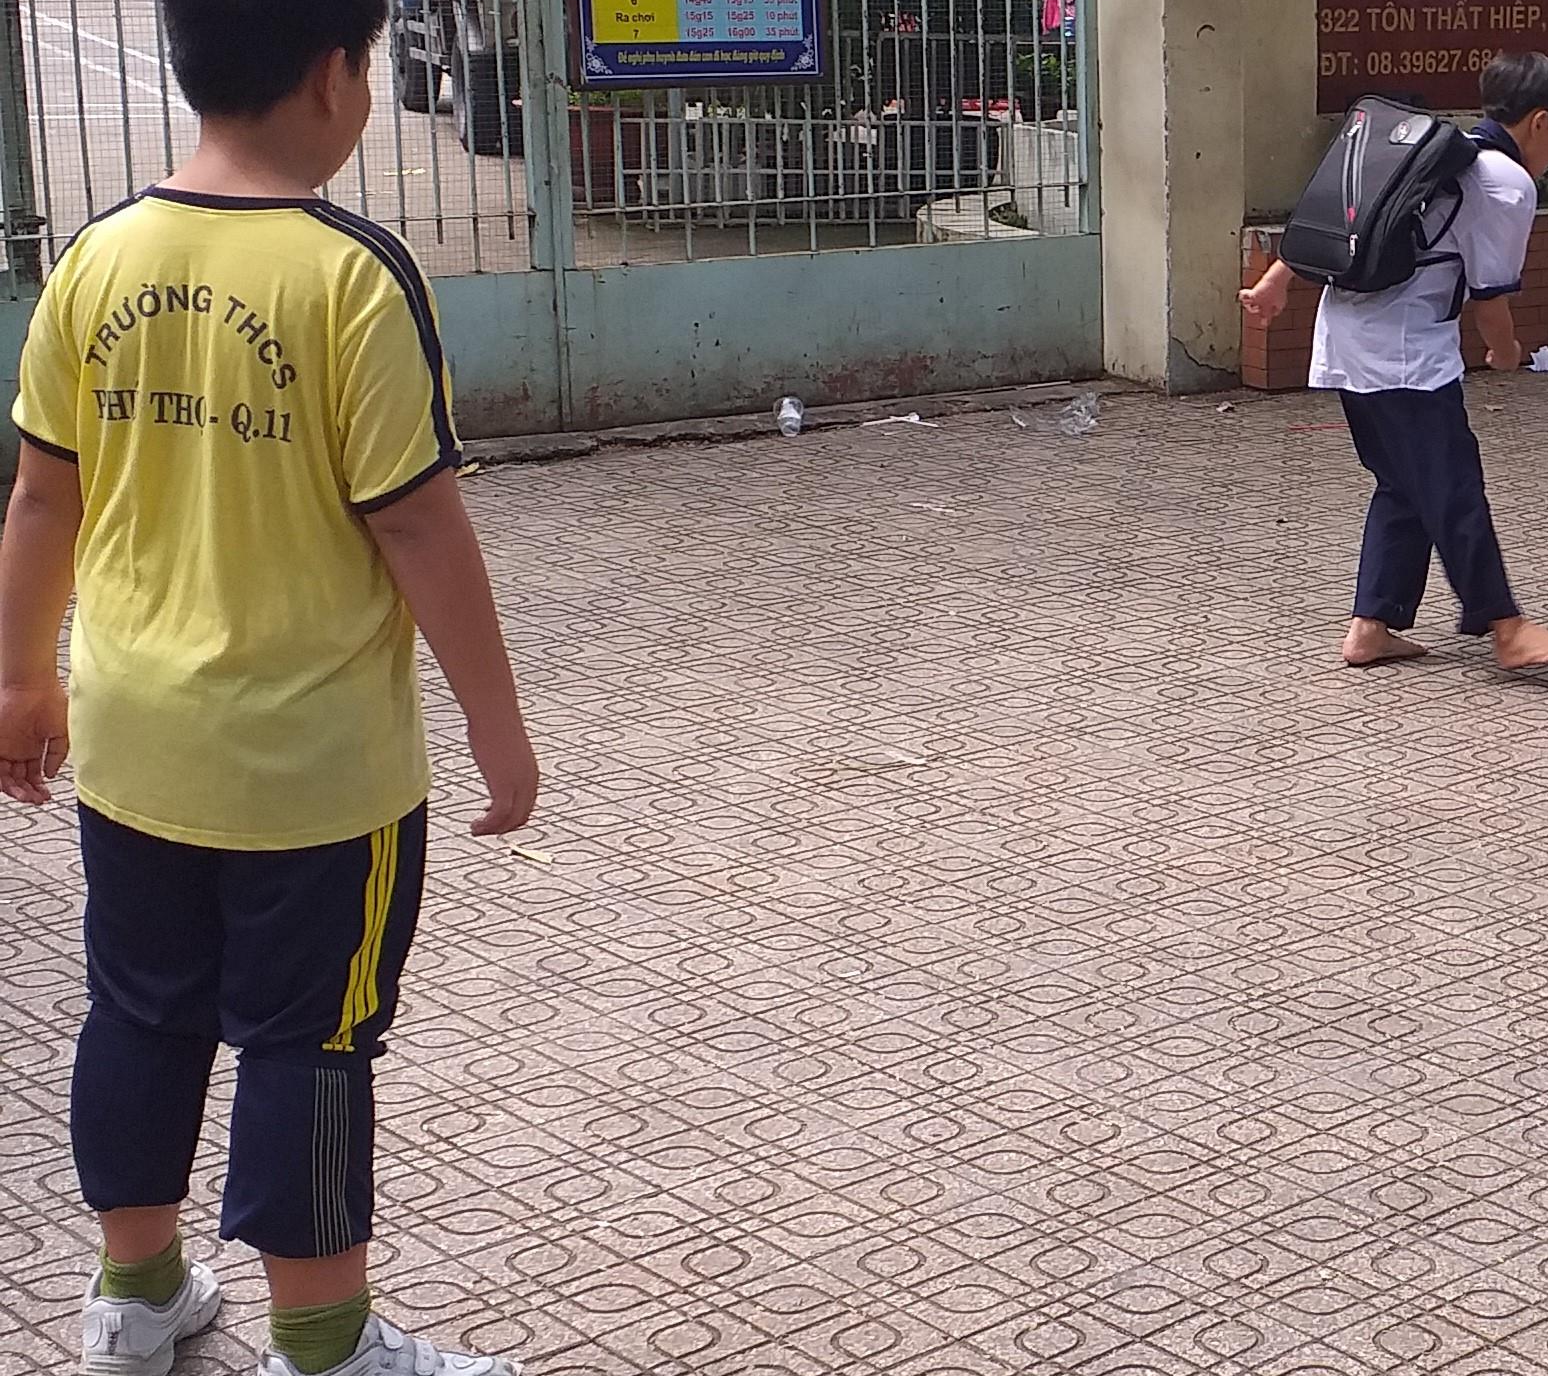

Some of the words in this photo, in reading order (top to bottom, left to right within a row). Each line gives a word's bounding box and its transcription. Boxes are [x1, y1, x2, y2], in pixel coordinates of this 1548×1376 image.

[616, 13, 630, 23] Ra
[631, 12, 655, 23] chơi
[1321, 8, 1360, 33] 322
[1366, 2, 1415, 31] TÔN
[1490, 0, 1546, 34] HIỆP,
[1321, 53, 1359, 76] ĐT:
[1367, 49, 1503, 74] 08.39627.68
[84, 282, 213, 367] TRƯỜNG
[223, 295, 297, 390] THCS
[231, 402, 292, 443] Q.11
